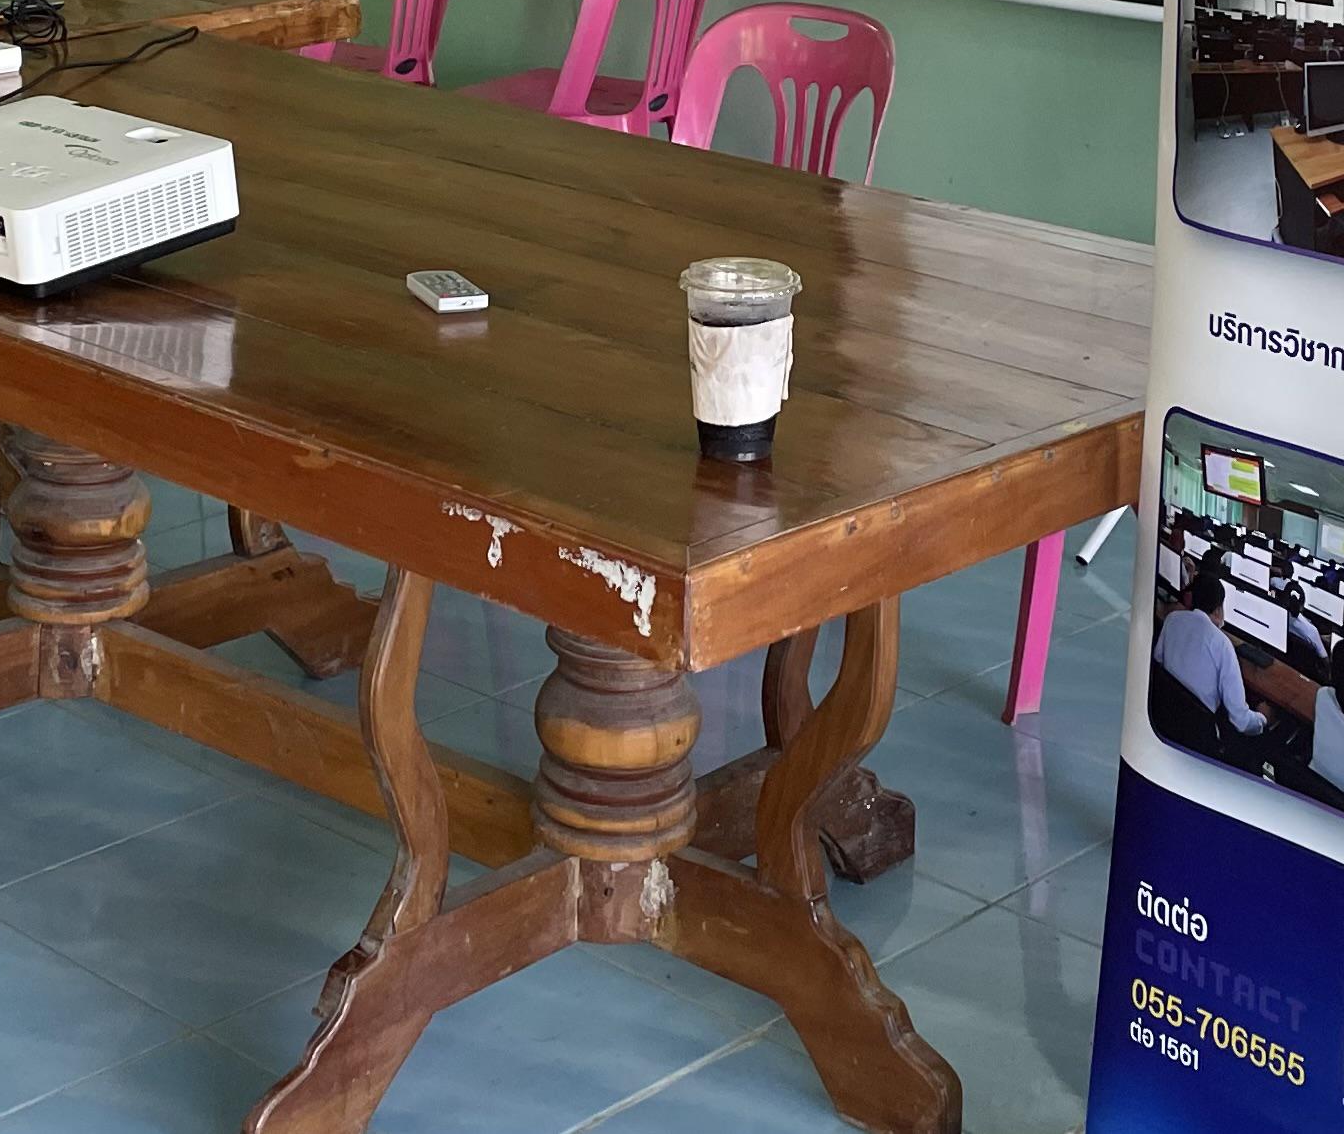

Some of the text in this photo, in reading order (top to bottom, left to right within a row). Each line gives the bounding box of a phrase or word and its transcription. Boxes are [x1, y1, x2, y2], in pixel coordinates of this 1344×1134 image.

[1137, 881, 1208, 941] ติดต่อ
[1135, 928, 1307, 1032] CONTACT
[1130, 1017, 1199, 1071] ต่อ 1561
[1132, 978, 1305, 1086] 055-706555
